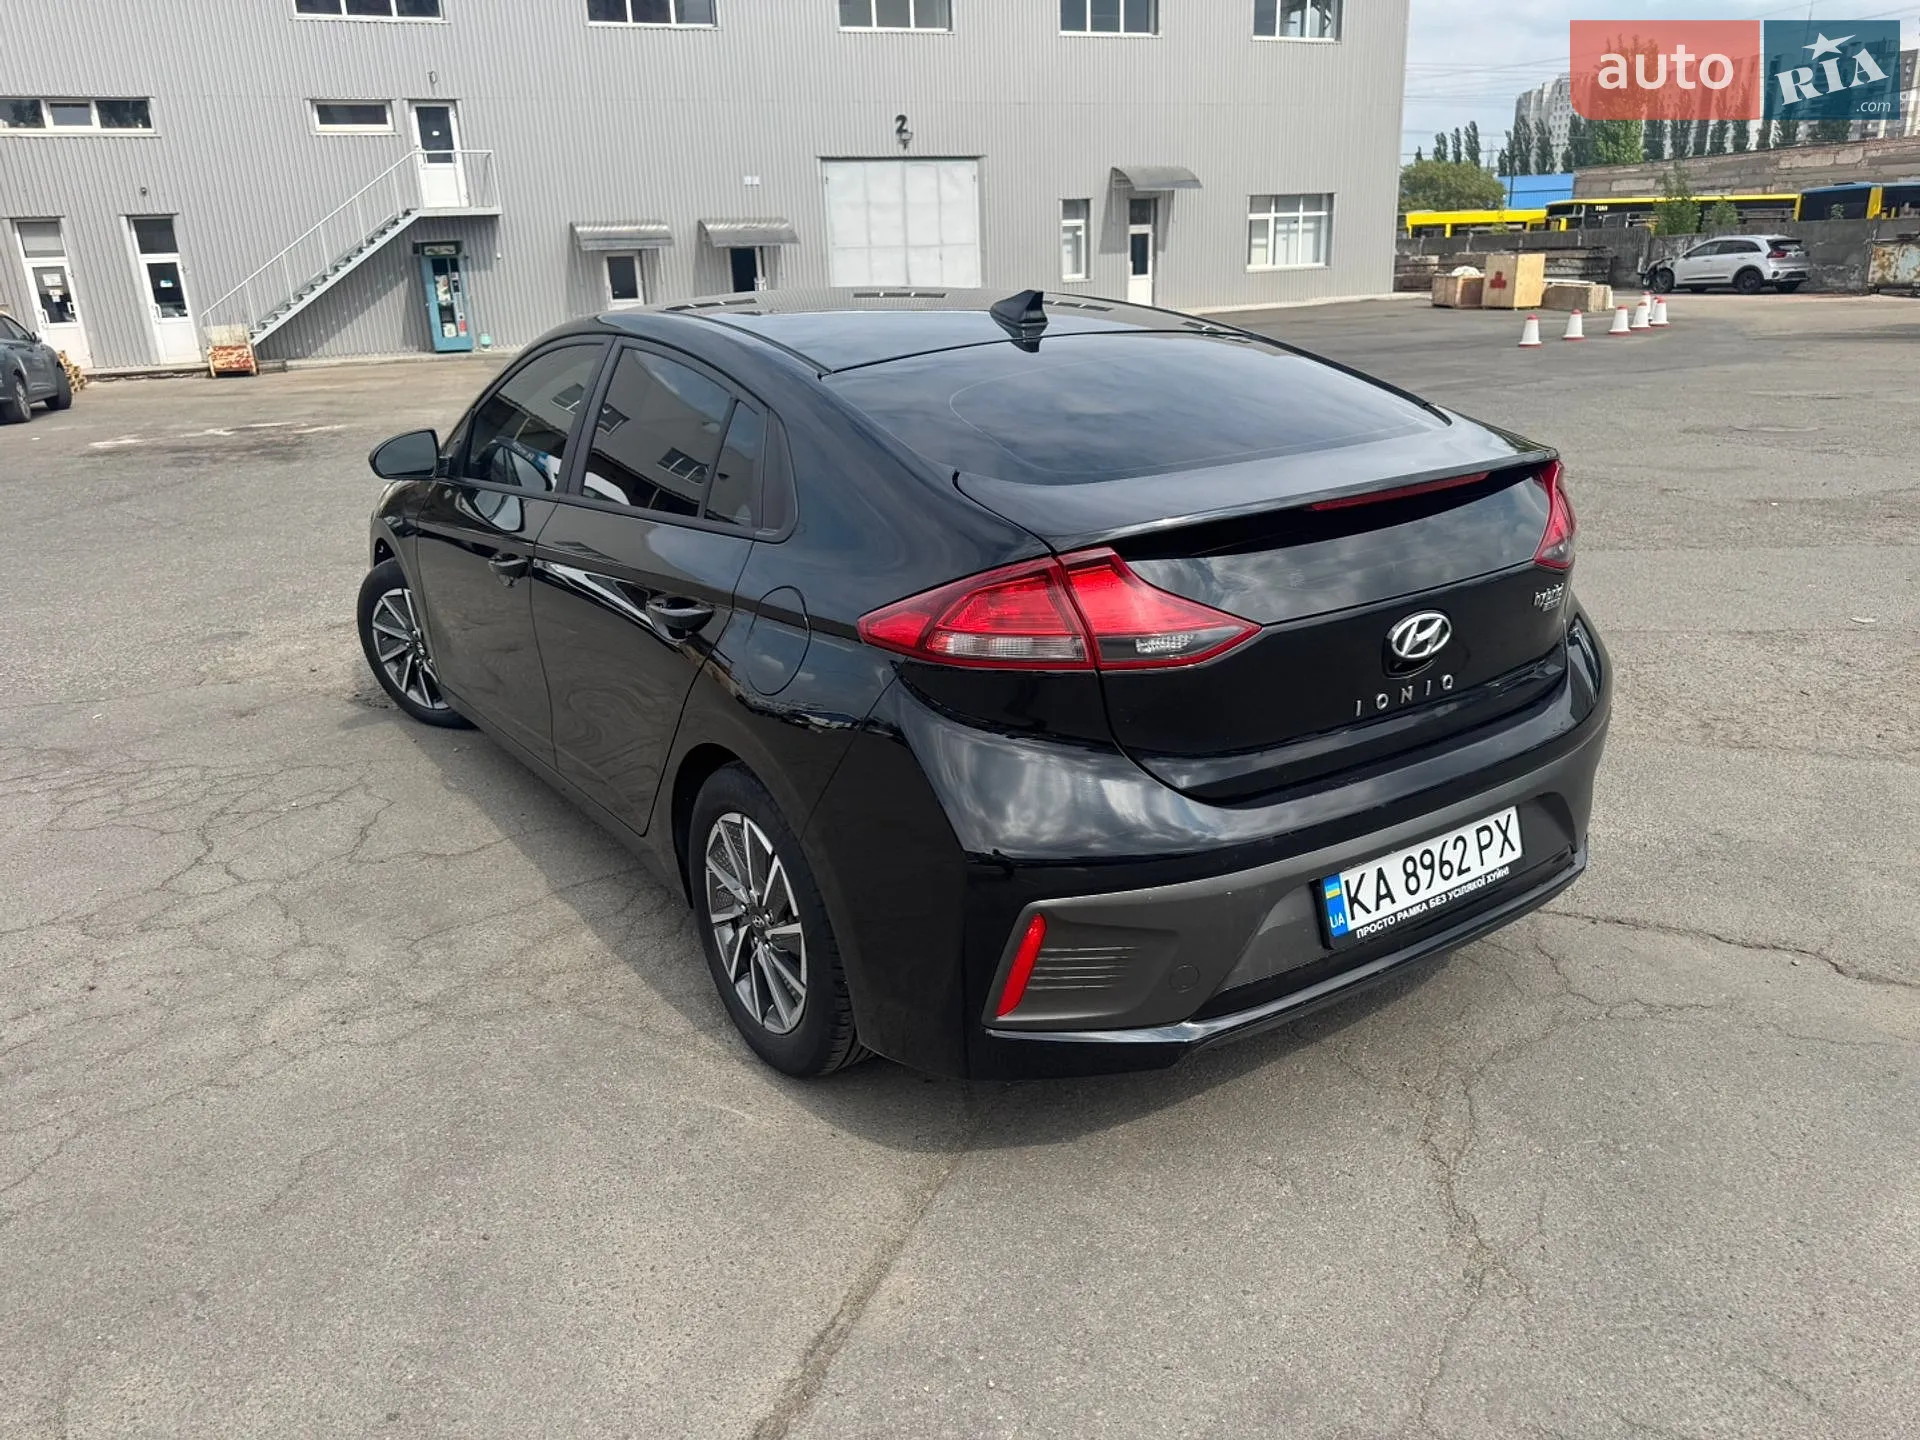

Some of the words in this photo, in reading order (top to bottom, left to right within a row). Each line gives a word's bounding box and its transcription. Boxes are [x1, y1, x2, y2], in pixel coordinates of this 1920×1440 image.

[895, 114, 908, 134] 2
[1355, 674, 1454, 717] IONIQ
[1344, 866, 1397, 921] KA
[1402, 834, 1472, 896] 8962
[1475, 813, 1516, 867] PX
[1329, 912, 1346, 929] UA
[1356, 915, 1396, 939] ПРОСТО
[1396, 903, 1429, 924] РАМКА
[1429, 894, 1447, 909] БЕЗ
